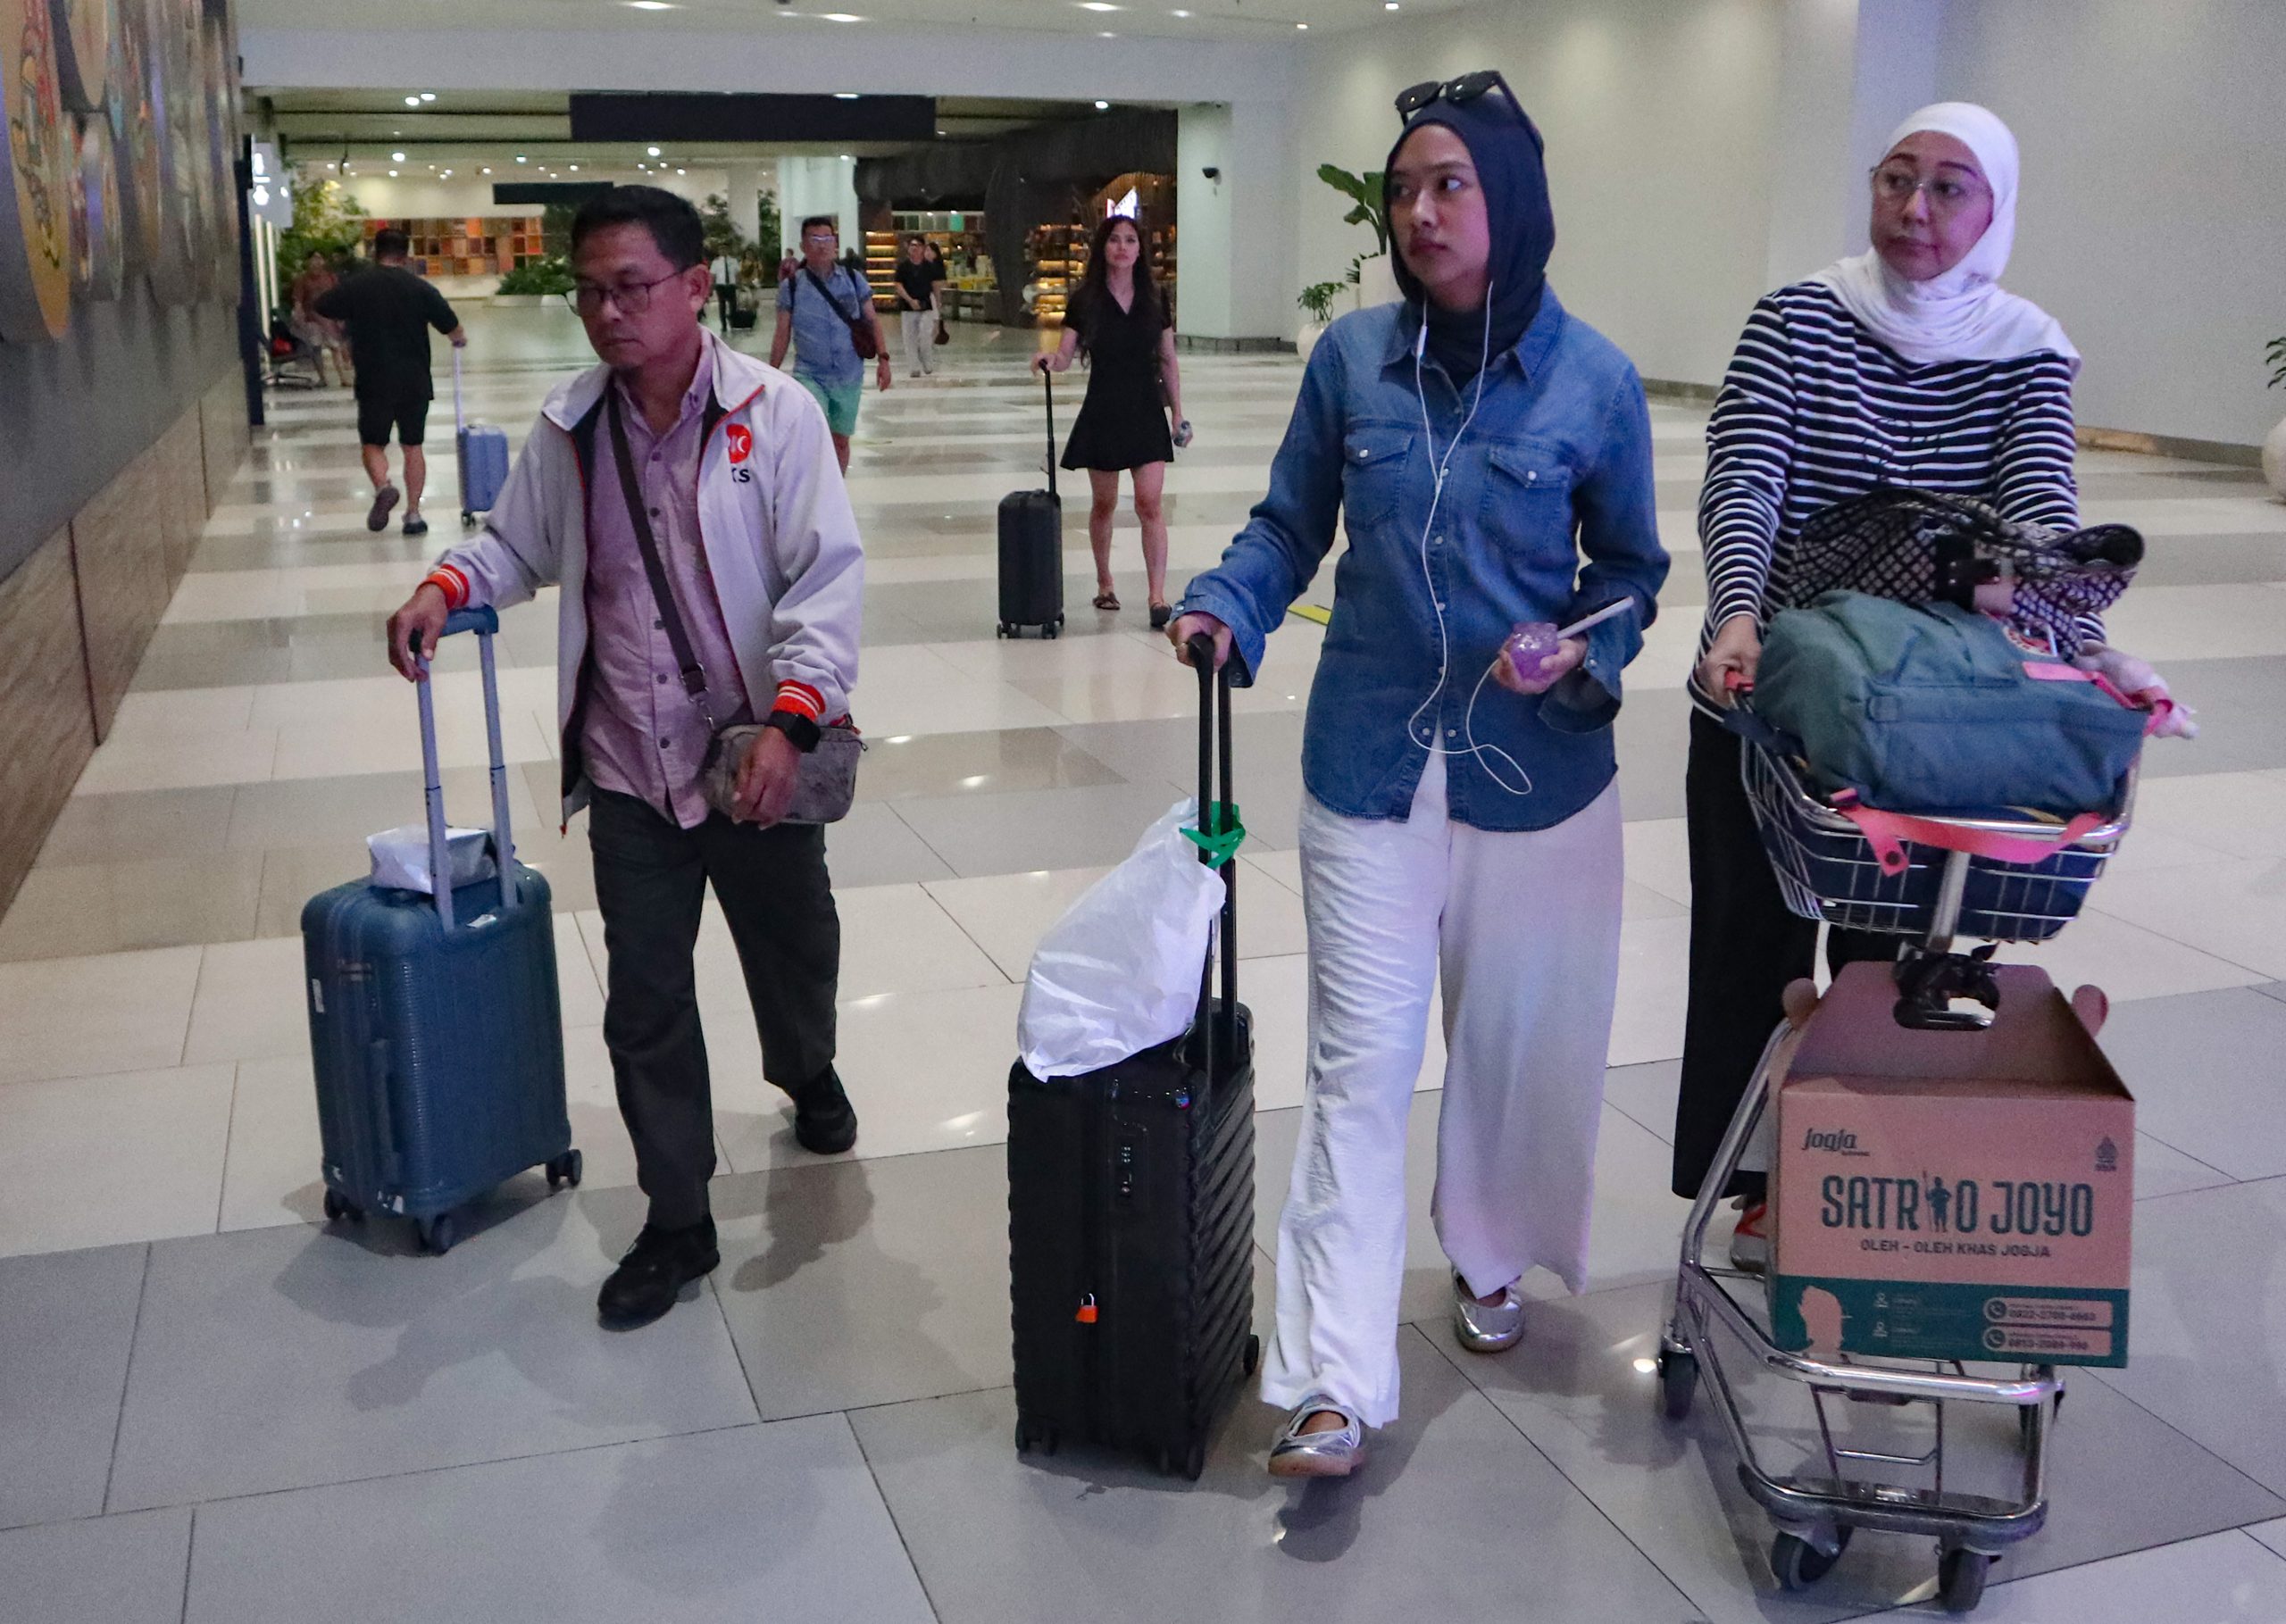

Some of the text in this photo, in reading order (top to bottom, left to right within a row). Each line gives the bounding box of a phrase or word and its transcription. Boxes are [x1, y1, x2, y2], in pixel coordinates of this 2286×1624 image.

[1990, 1180, 2094, 1237] JOYO
[1860, 1238, 1898, 1252] OLEH
[1914, 1240, 1952, 1254] OLEH
[1957, 1243, 1997, 1256] KHAS
[2001, 1244, 2051, 1258] JOGJA
